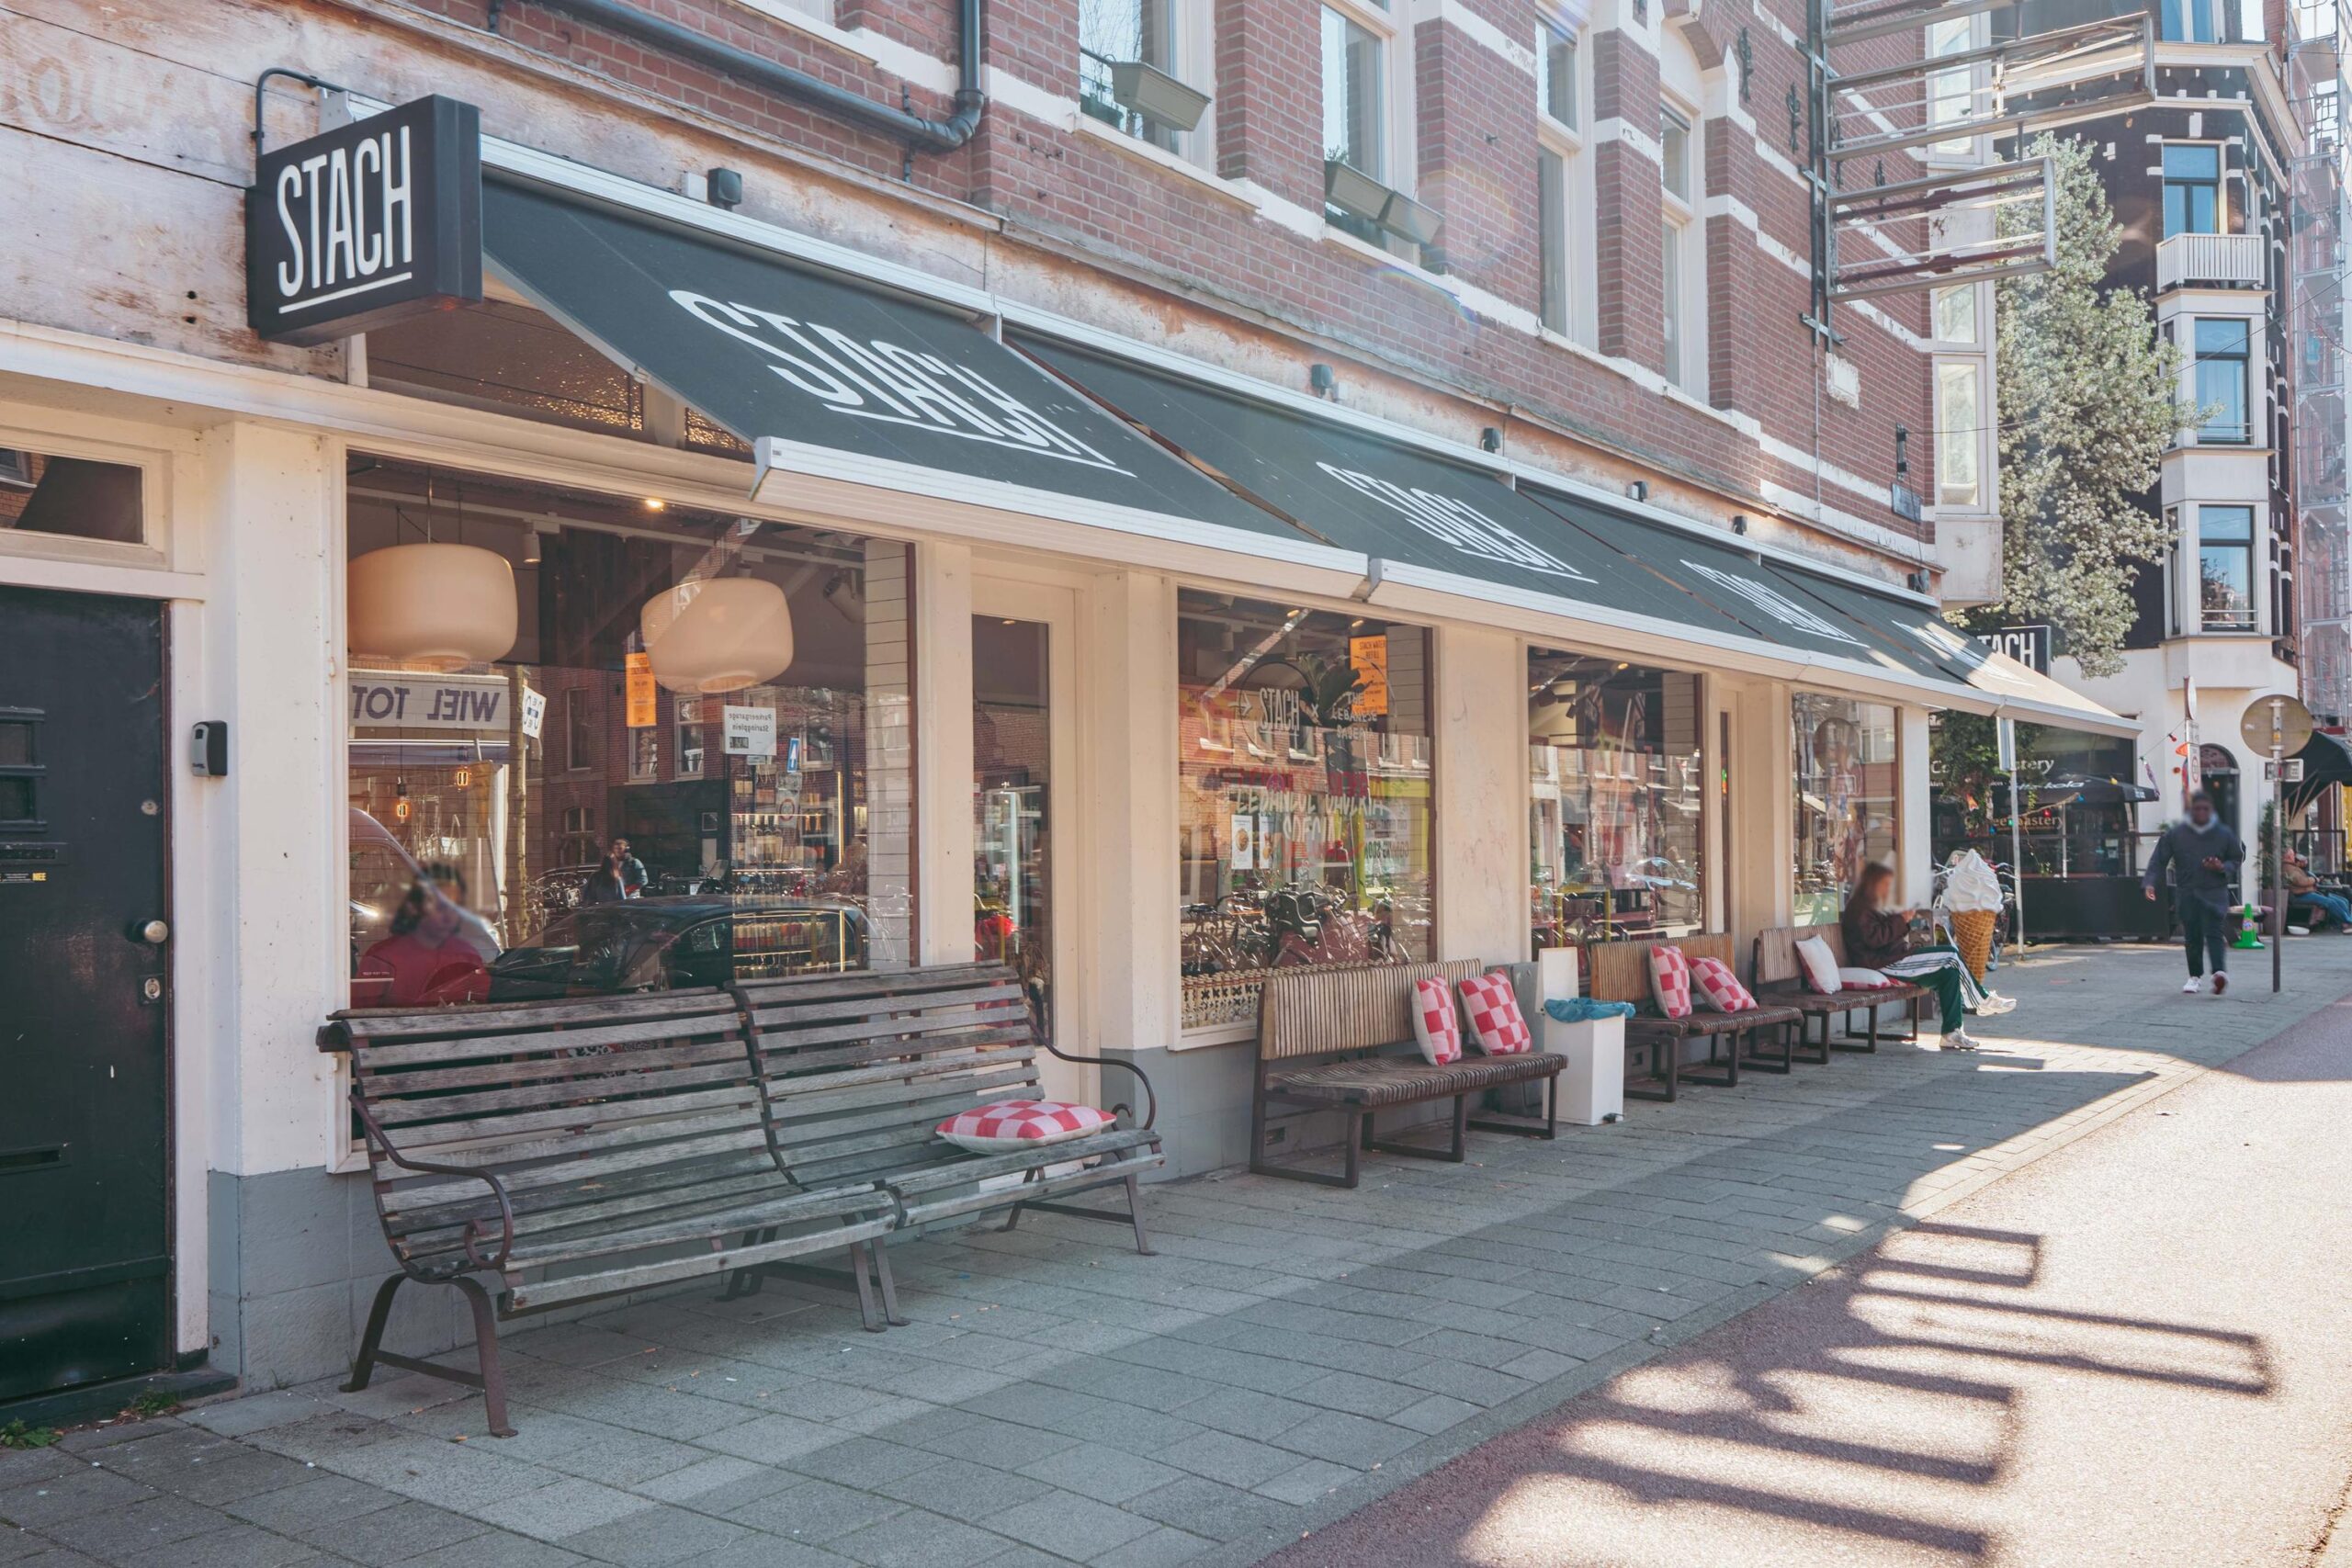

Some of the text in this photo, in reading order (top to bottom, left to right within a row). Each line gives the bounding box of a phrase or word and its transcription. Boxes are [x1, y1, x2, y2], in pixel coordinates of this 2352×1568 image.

[277, 125, 413, 298] STACH
[669, 290, 1117, 466] STACH
[1316, 461, 1582, 574] STACH
[1259, 688, 1300, 731] STACH
[1346, 692, 1364, 705] THE
